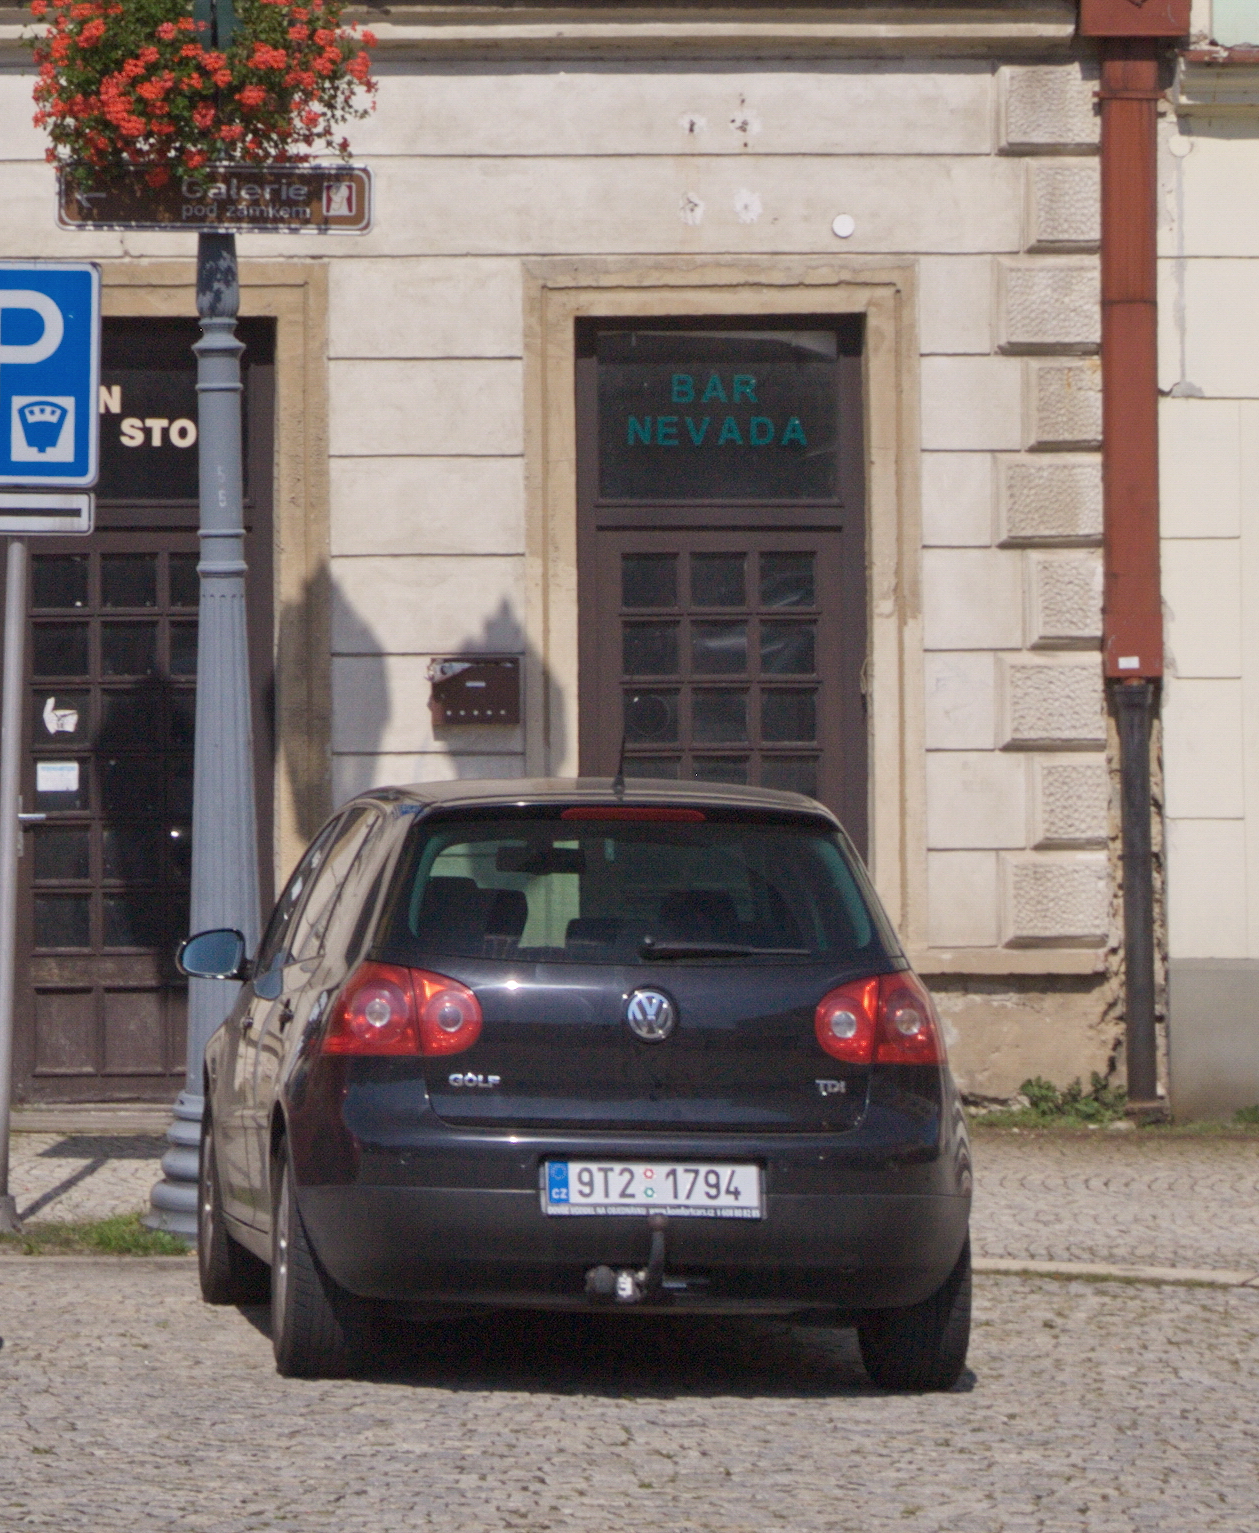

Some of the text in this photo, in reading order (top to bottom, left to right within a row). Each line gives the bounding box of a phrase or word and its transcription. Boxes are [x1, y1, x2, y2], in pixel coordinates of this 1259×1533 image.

[182, 178, 308, 201] Galerie
[182, 203, 218, 219] pod
[671, 374, 758, 404] BAR
[627, 416, 808, 446] NEVADA
[448, 1072, 501, 1088] GOLF
[815, 1080, 847, 1095] TDI
[552, 1188, 568, 1198] CZ
[577, 1167, 741, 1201] 9T2 1794
